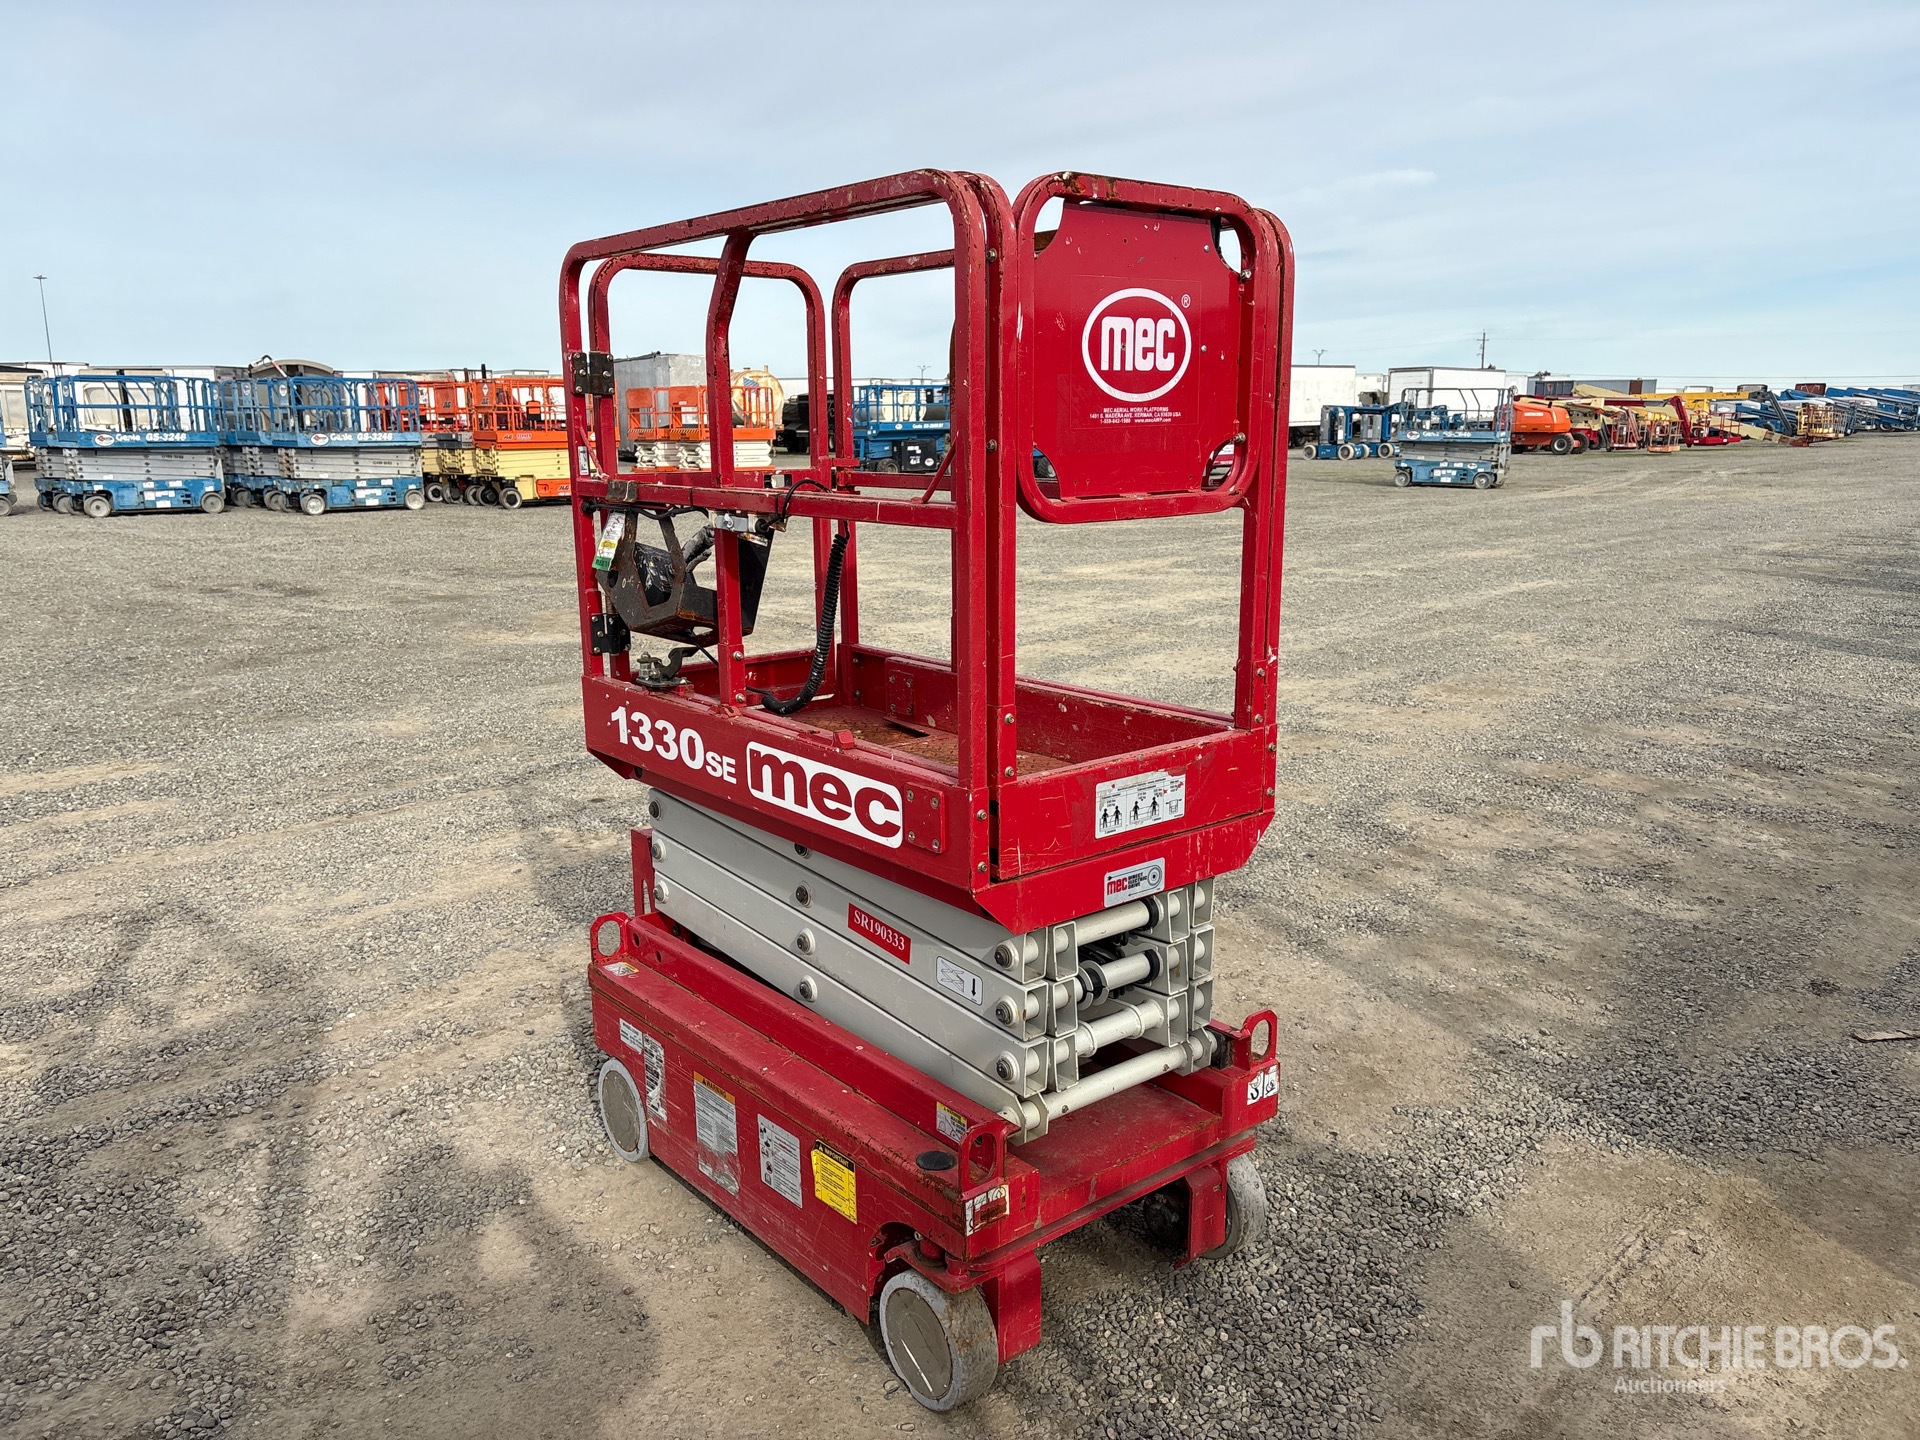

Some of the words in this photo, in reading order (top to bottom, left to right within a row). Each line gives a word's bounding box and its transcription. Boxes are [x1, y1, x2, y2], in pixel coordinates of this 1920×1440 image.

[115, 433, 141, 441] Genie
[145, 433, 187, 441] GS-3246
[330, 433, 353, 441] Genie
[357, 432, 393, 441] GS-3246
[749, 748, 902, 839] mec
[853, 909, 905, 951] SR190333
[706, 1081, 727, 1099] WARNING
[824, 1147, 850, 1168] IMPORTANT
